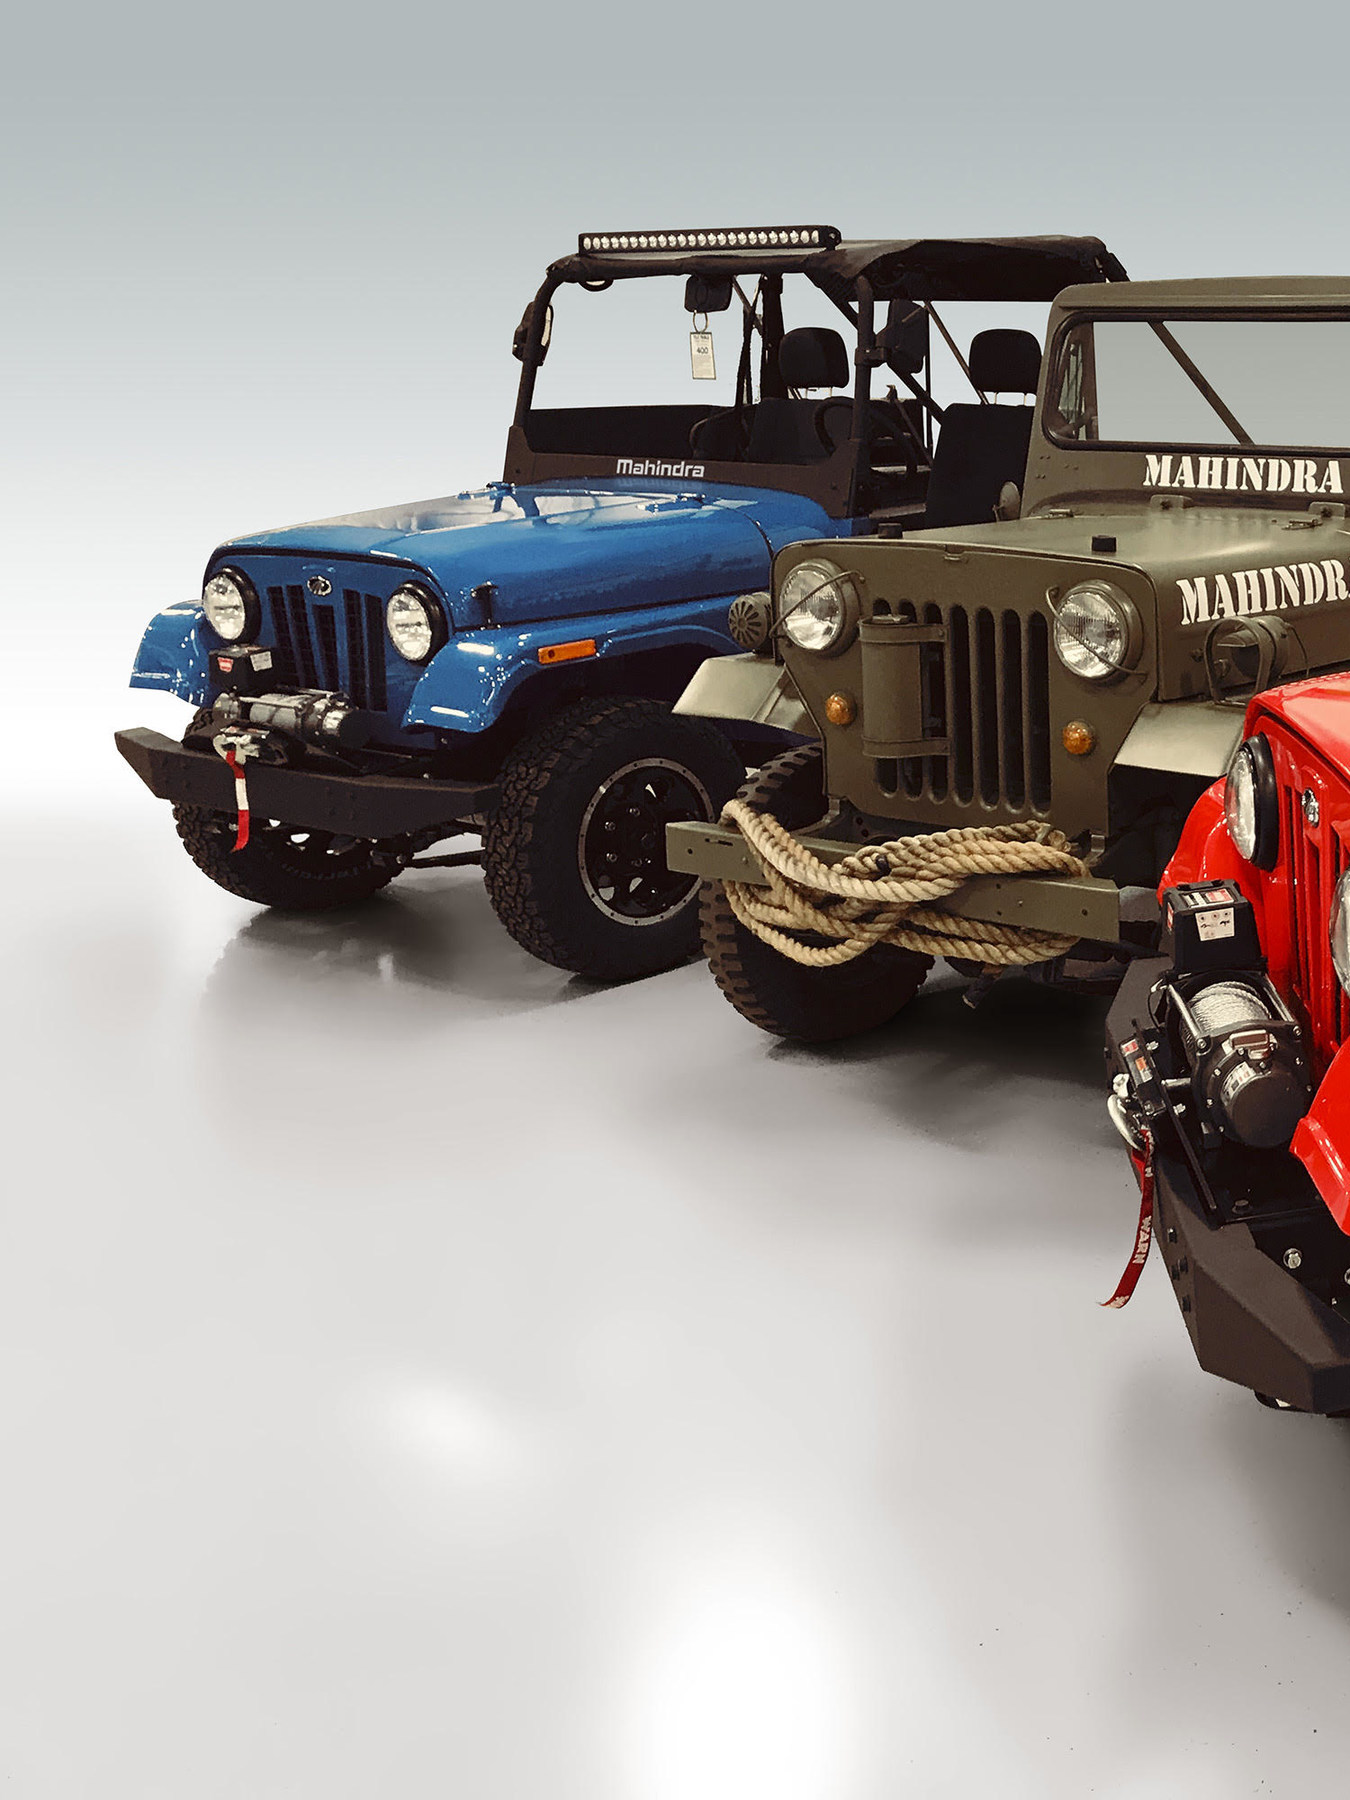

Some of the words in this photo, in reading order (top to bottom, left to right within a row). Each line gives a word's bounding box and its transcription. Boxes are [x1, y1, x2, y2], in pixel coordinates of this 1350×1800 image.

[616, 459, 705, 477] Mahindra
[1143, 454, 1344, 494] MAHINDRA
[1132, 1215, 1153, 1264] WARN
